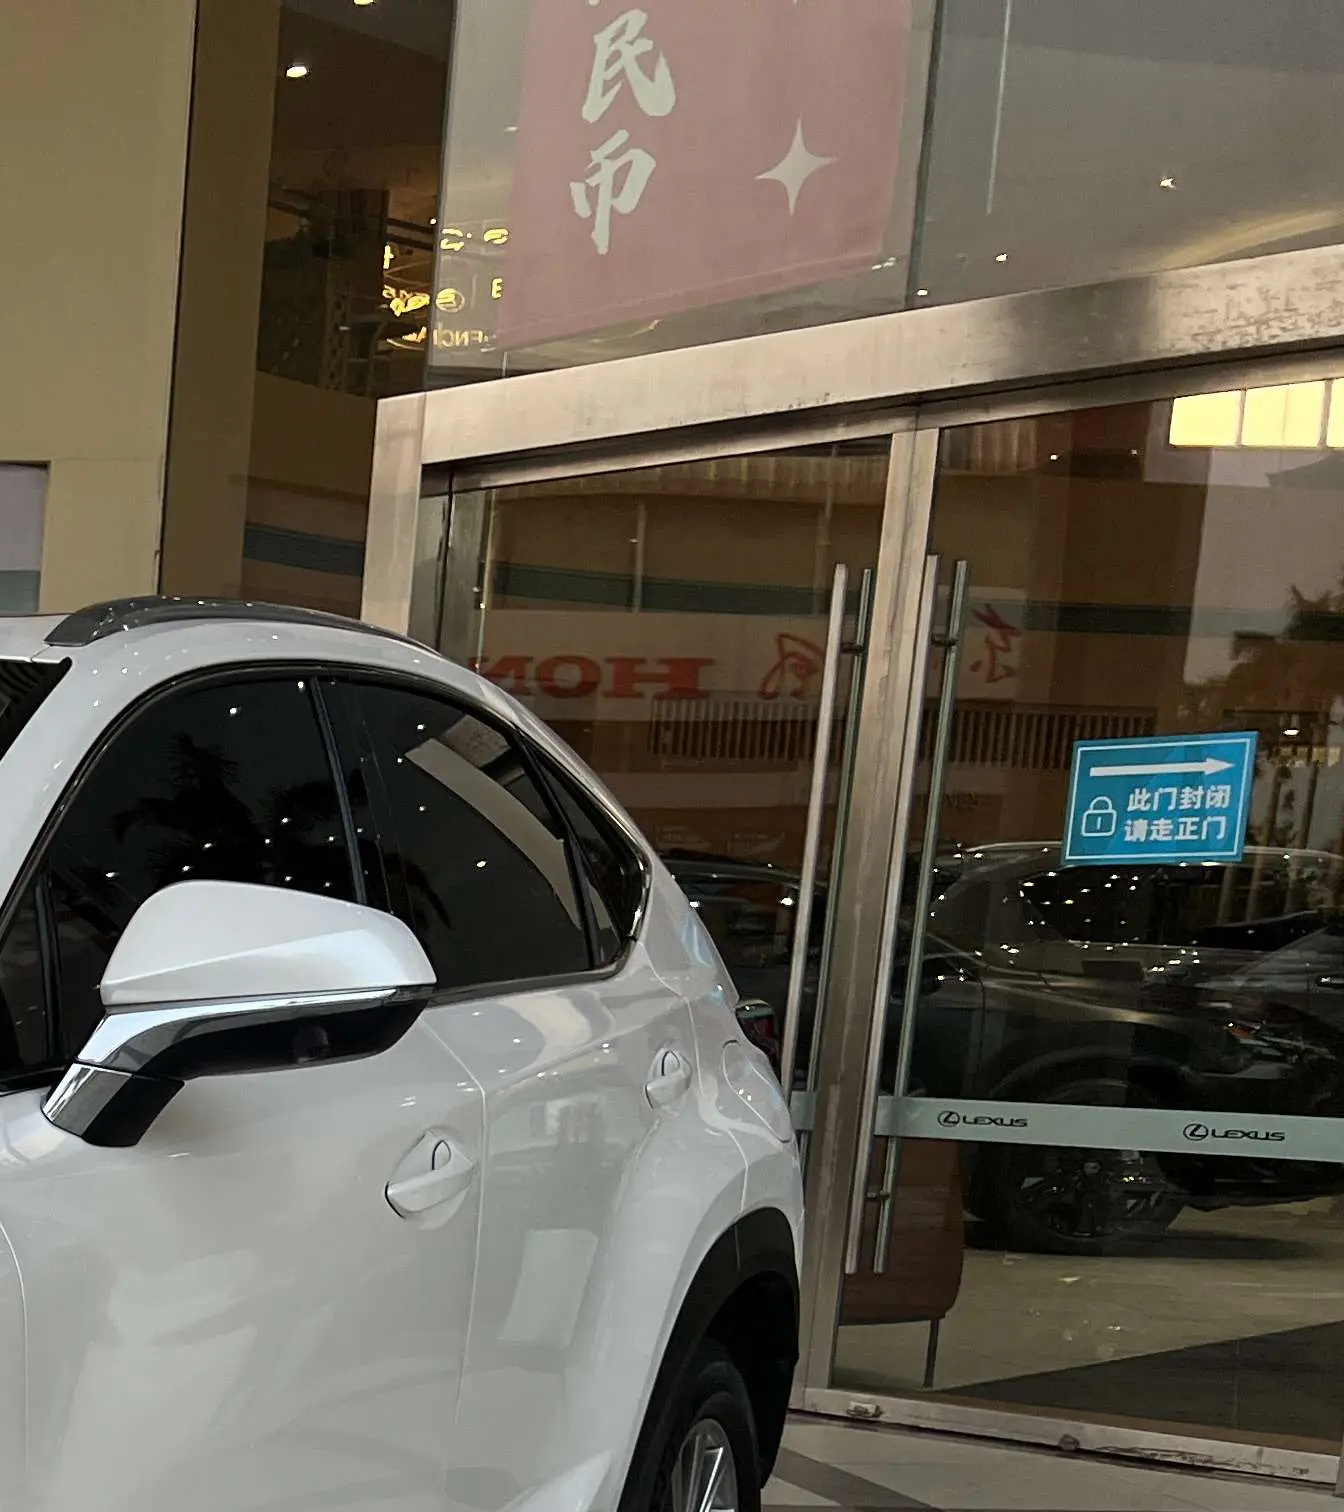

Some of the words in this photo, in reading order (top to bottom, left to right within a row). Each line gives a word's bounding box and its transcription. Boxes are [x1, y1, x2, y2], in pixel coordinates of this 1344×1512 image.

[569, 0, 676, 254] 民币
[1127, 785, 1231, 812] 此门封闭
[1123, 816, 1227, 842] 请走正门
[962, 1115, 1028, 1128] LEXUS
[1211, 1128, 1286, 1142] LEXUS
